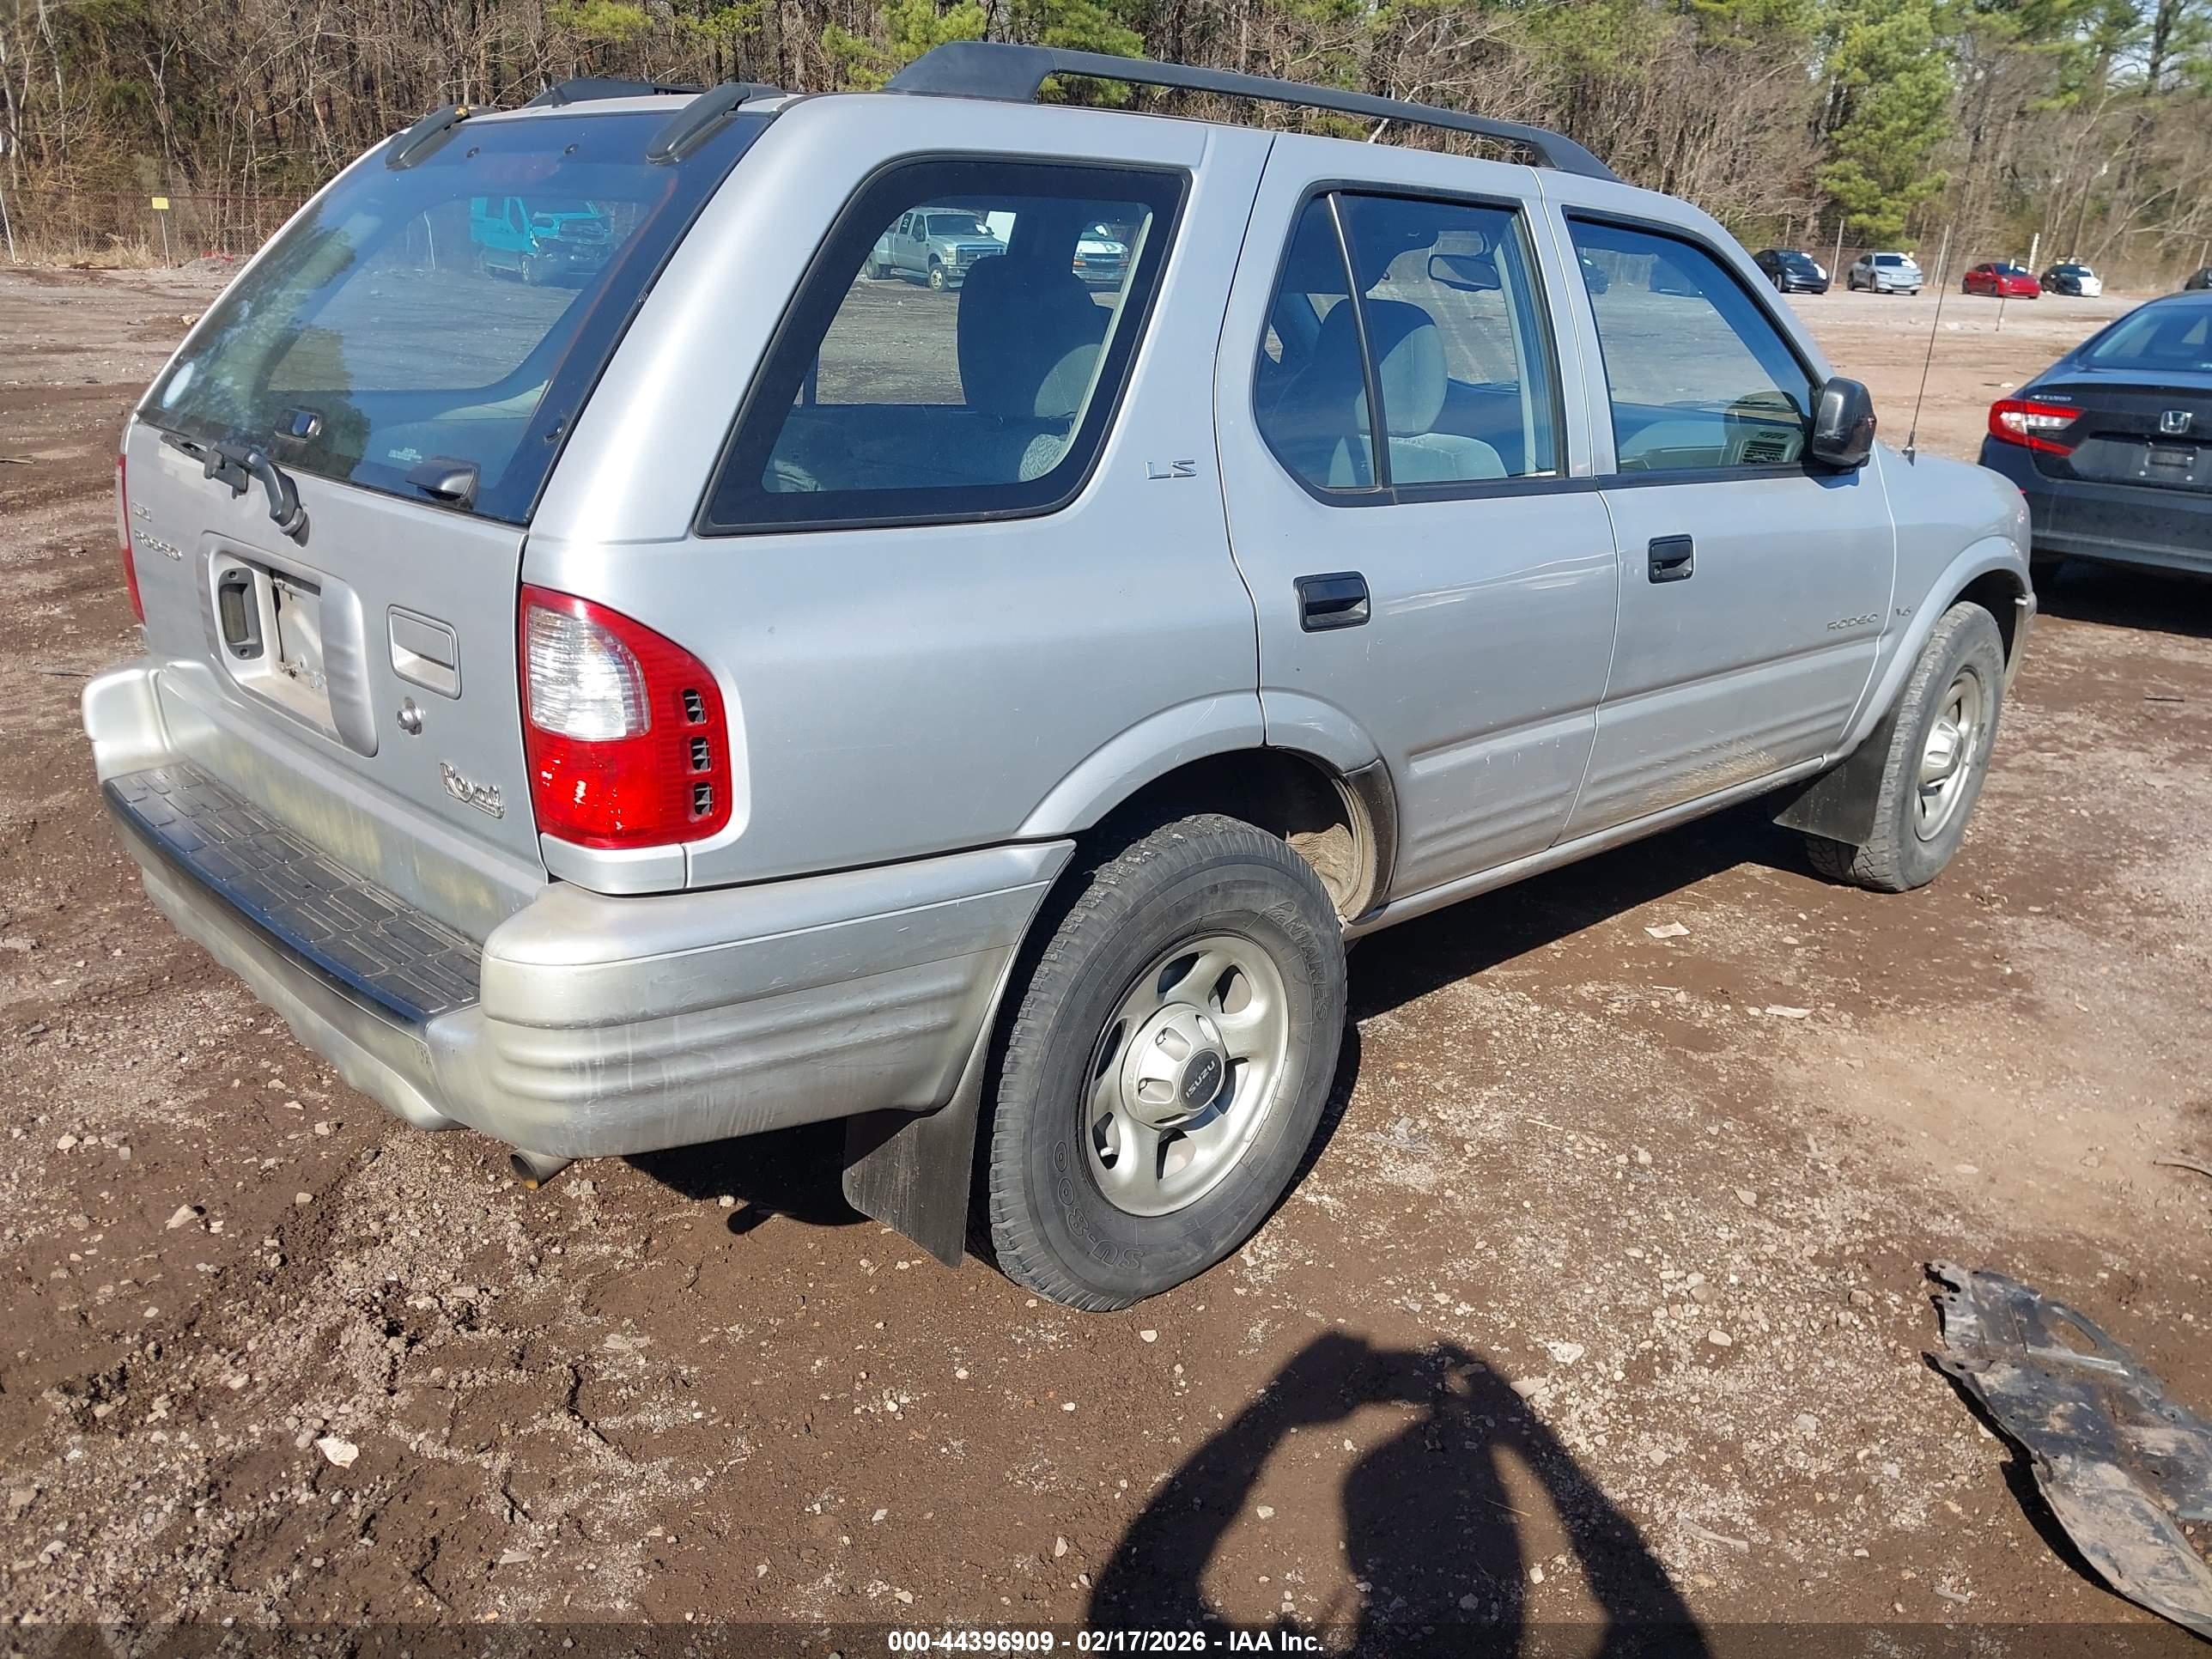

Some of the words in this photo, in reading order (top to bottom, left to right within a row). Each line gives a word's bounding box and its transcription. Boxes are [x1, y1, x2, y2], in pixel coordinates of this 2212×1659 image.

[1145, 459, 1197, 480] LS
[1826, 613, 1878, 632] RODEO
[1185, 1060, 1216, 1098] ISUZU
